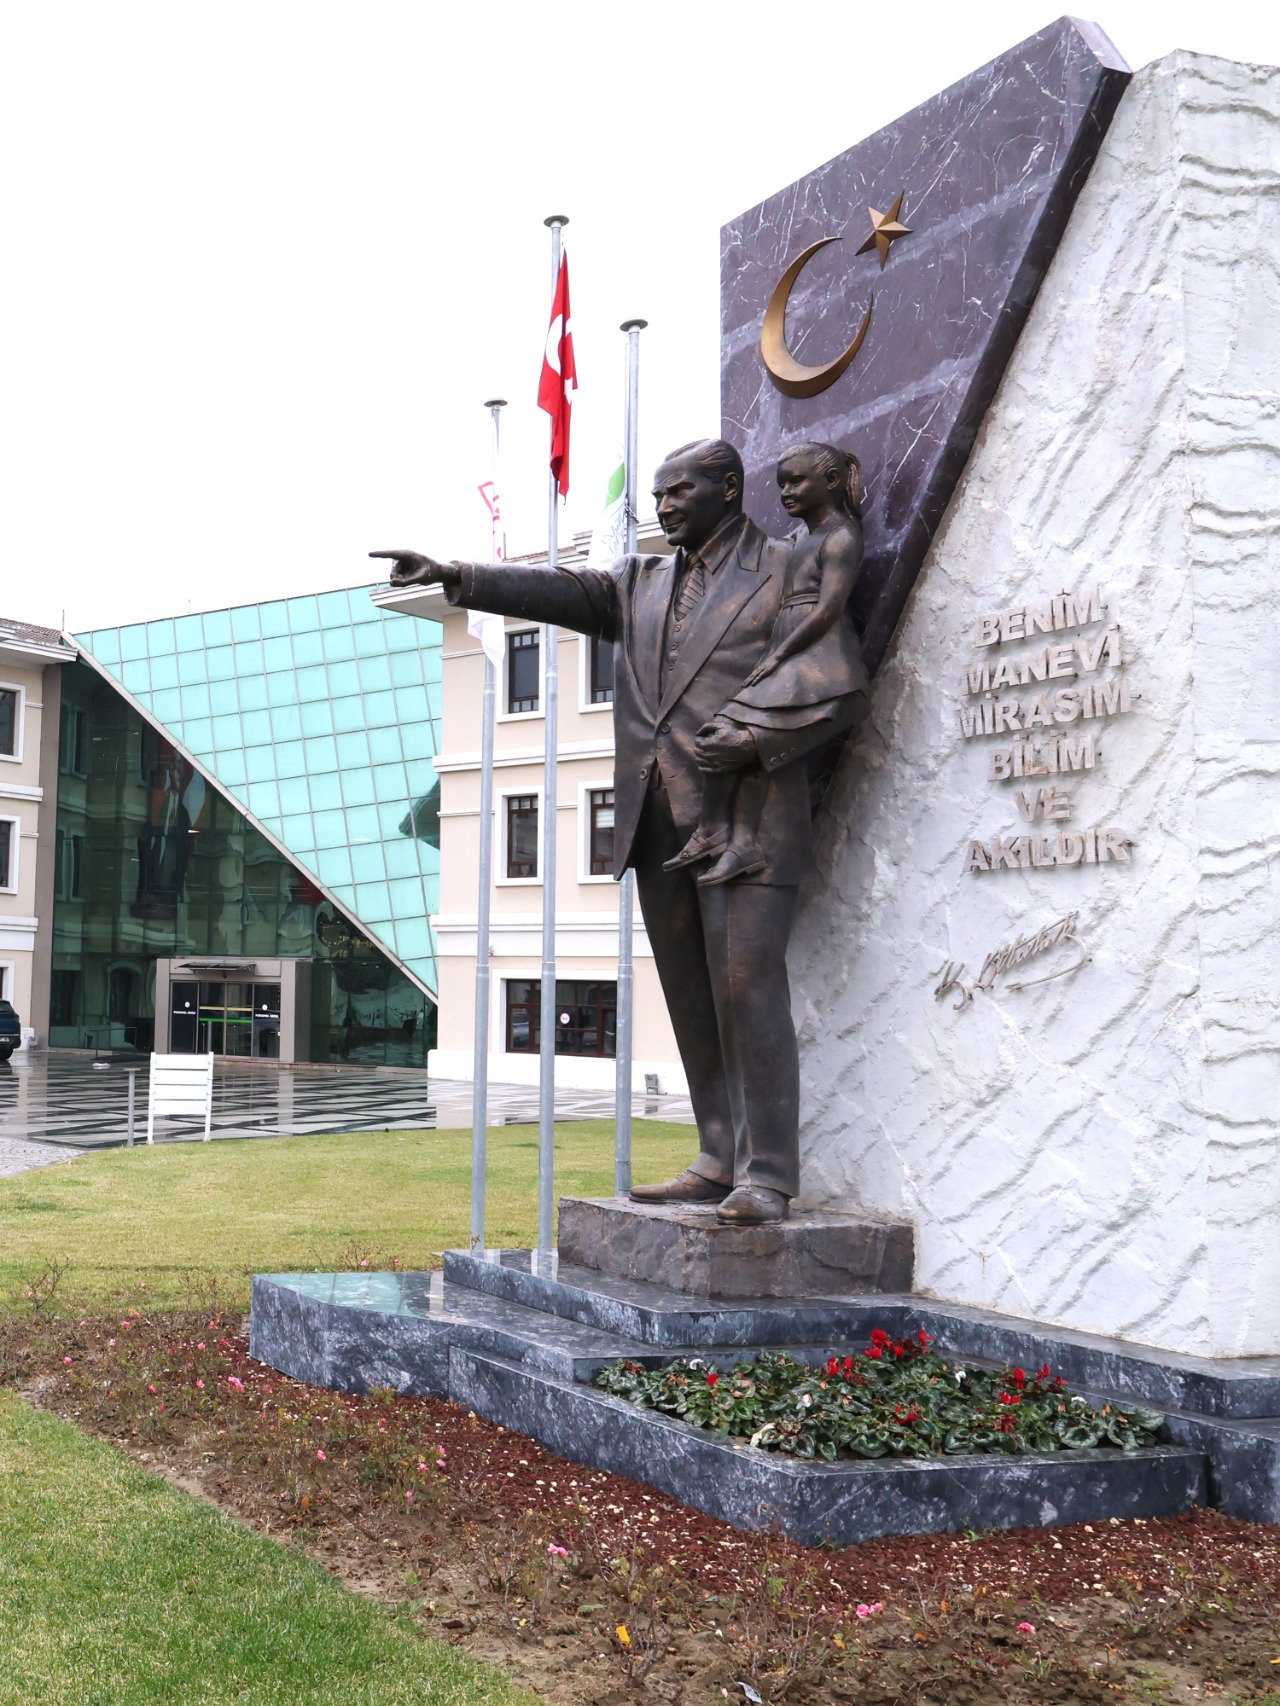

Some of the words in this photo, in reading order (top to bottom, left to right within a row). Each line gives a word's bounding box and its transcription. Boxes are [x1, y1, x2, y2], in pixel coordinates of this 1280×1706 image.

[974, 588, 1102, 648] BENİM
[962, 624, 1122, 696] MANEVİ
[955, 678, 1132, 738] MİRASIM
[987, 729, 1095, 782] BİLİM
[1015, 786, 1070, 822] VE
[962, 827, 1129, 873] AKILDIR
